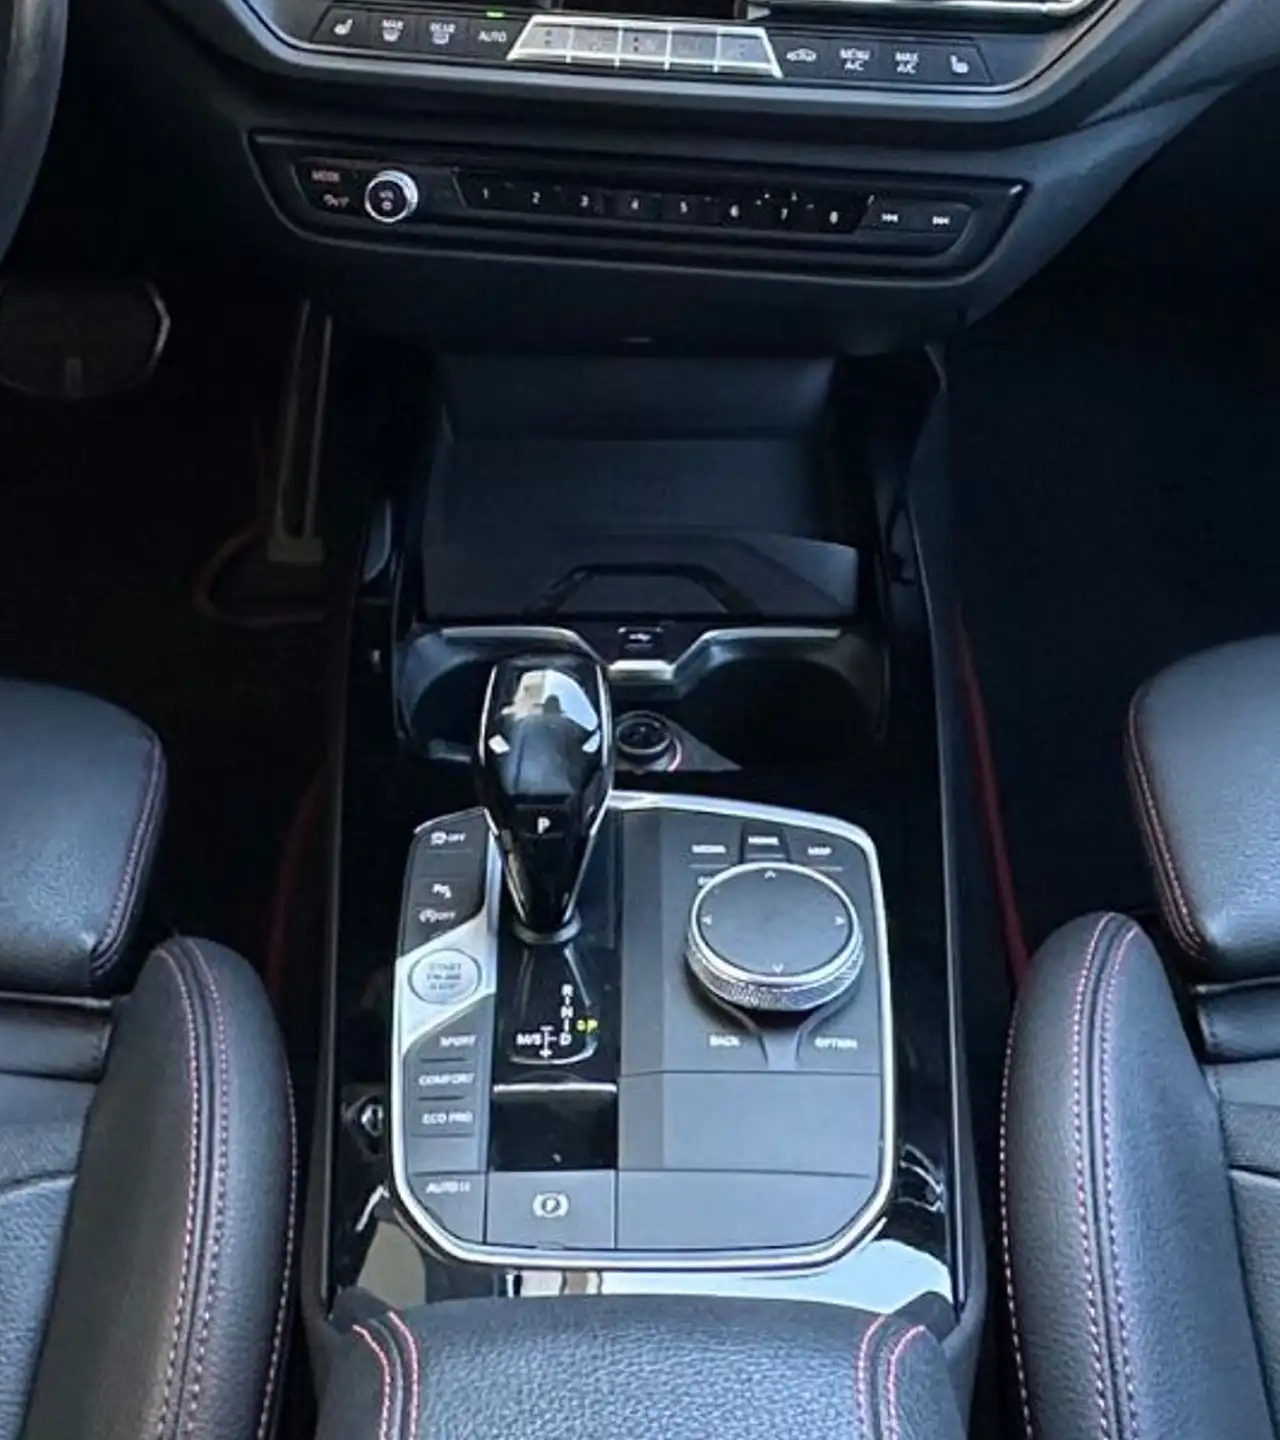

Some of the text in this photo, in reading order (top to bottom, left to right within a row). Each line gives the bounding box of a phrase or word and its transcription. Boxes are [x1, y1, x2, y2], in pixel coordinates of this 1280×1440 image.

[478, 30, 507, 43] AUTO
[895, 52, 919, 62] MAX
[844, 61, 864, 72] A/C
[896, 63, 916, 74] A/C
[532, 192, 541, 204] 2
[580, 194, 590, 208] 3
[537, 816, 551, 834] P
[561, 984, 573, 997] R
[561, 1006, 573, 1018] N
[587, 1019, 598, 1031] P
[559, 1033, 572, 1045] D
[709, 1035, 740, 1047] BACK
[814, 1036, 858, 1050] OPTION
[418, 1074, 475, 1086] COMFORT
[422, 1112, 473, 1125] ECO PRO
